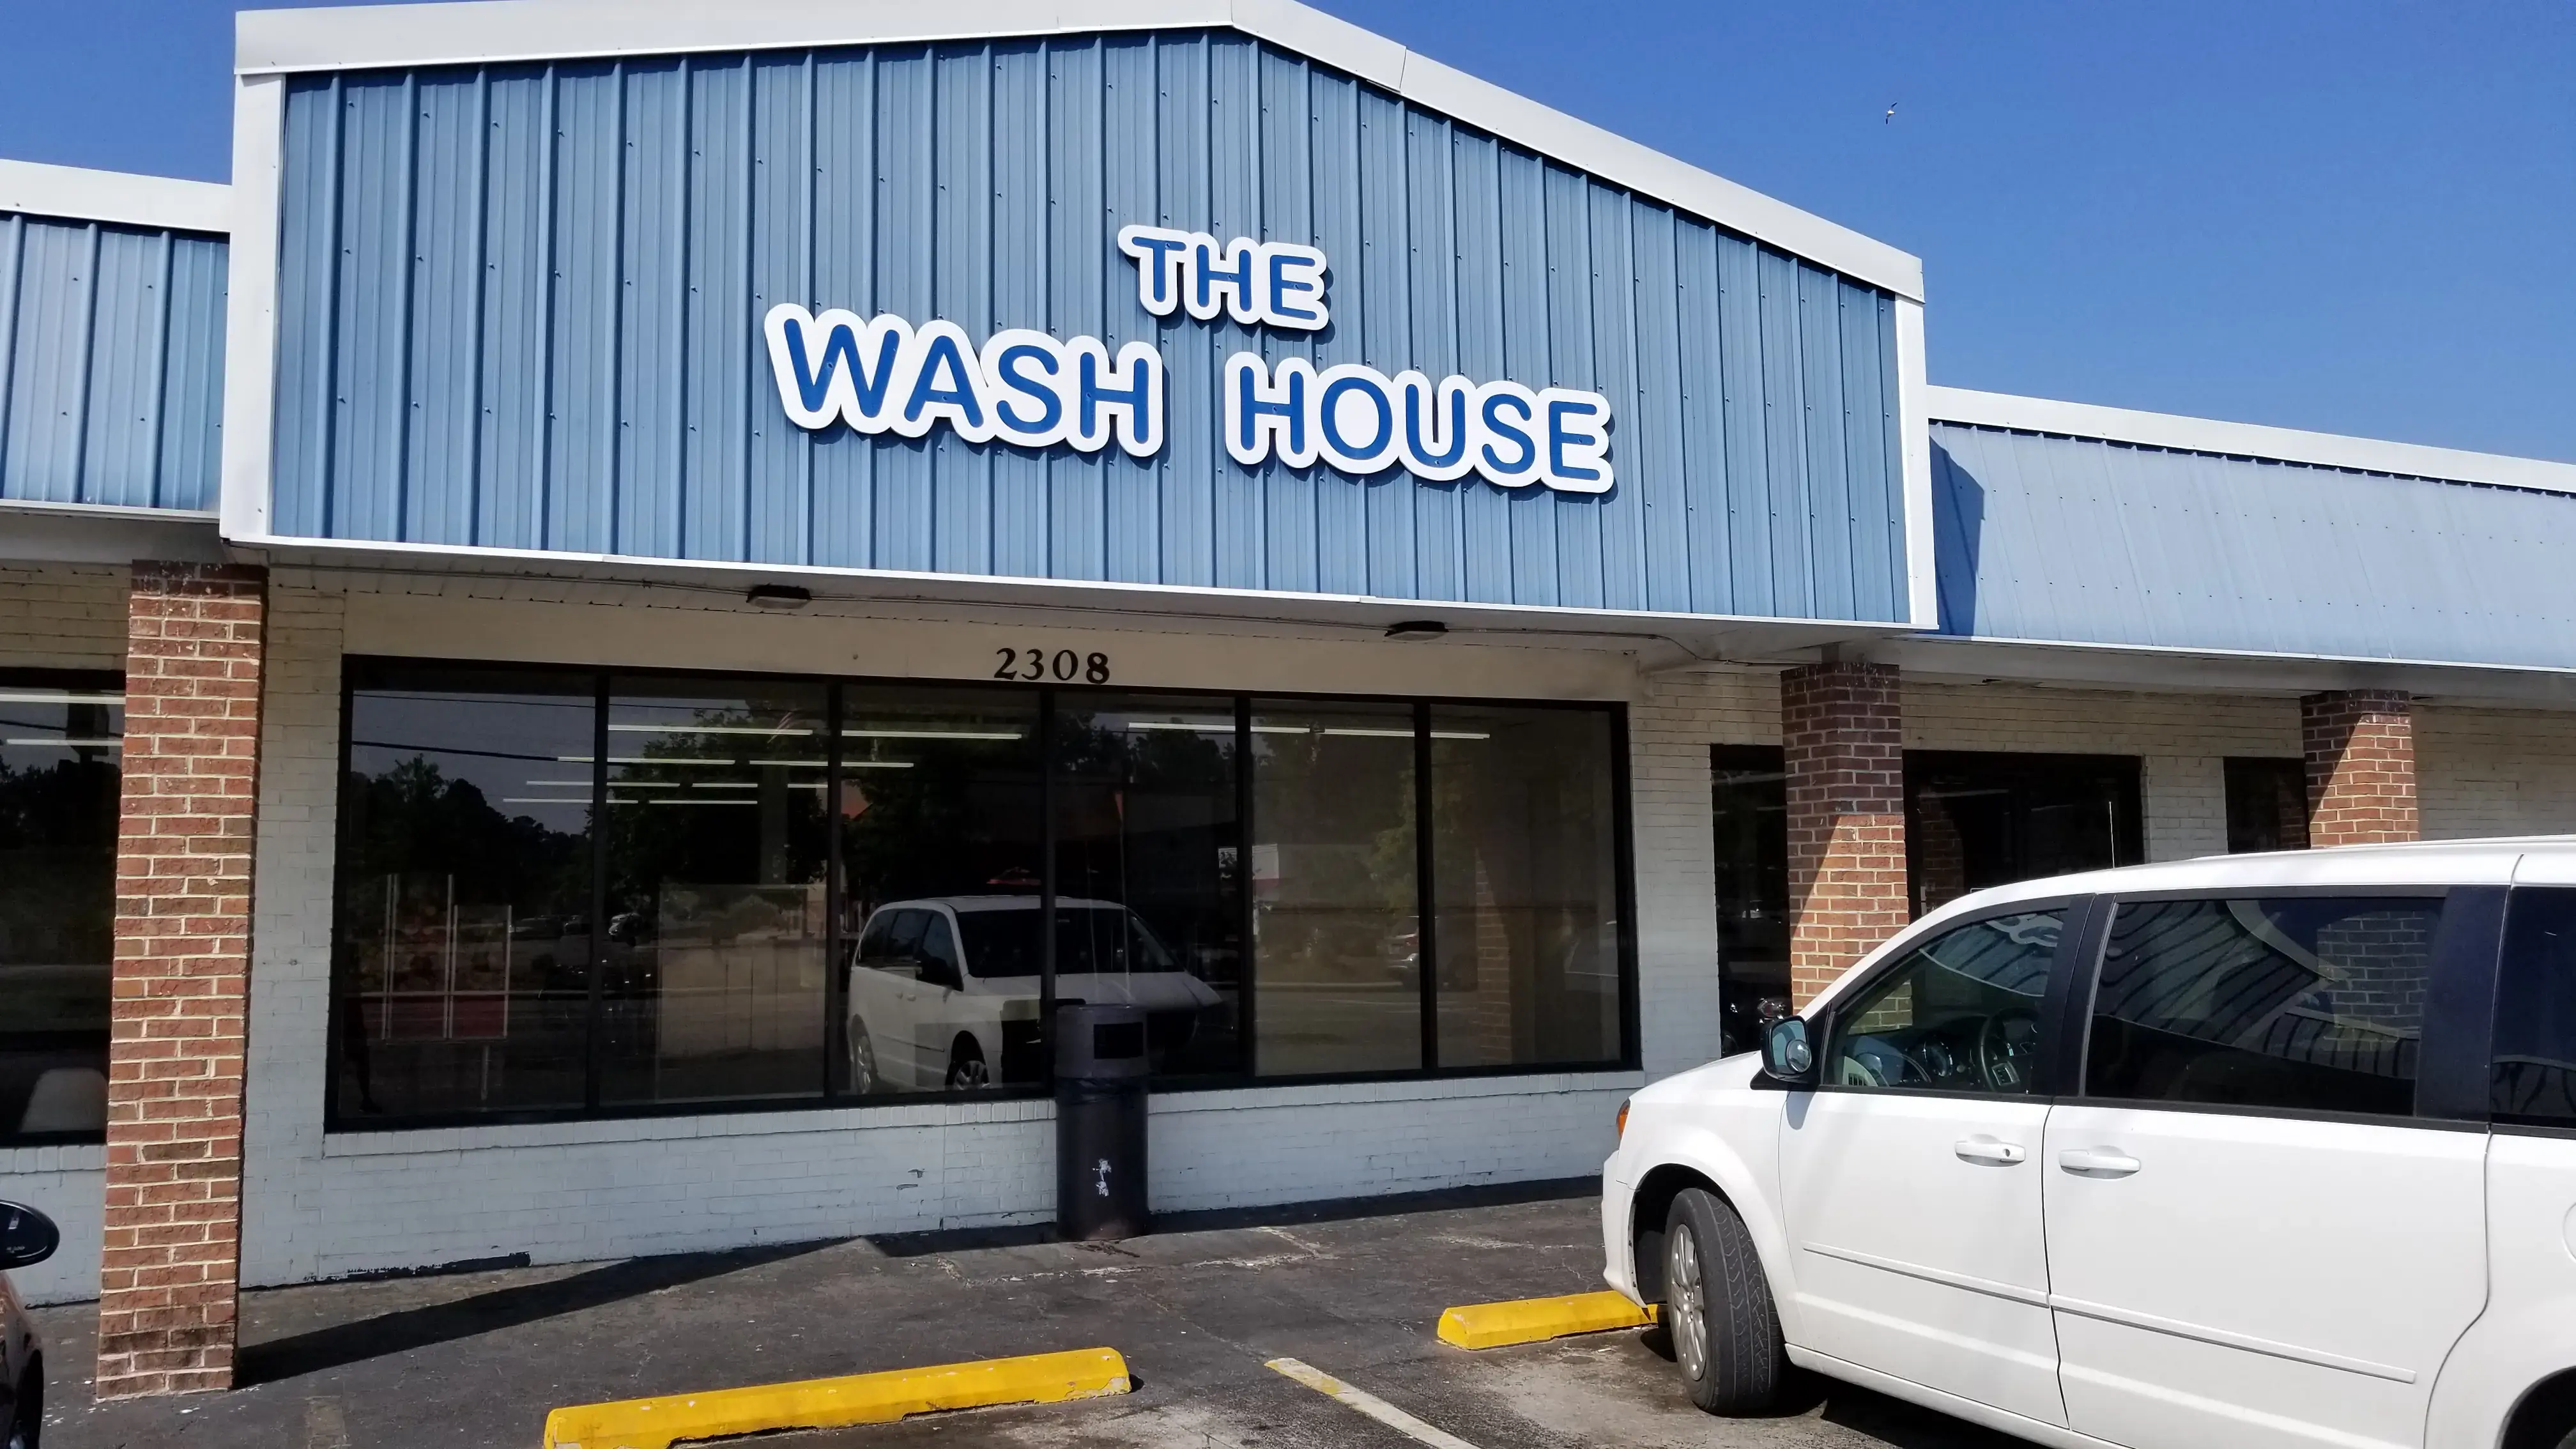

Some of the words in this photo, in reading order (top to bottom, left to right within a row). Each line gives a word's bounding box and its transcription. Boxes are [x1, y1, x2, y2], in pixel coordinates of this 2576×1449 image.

[1130, 234, 1322, 322] THE
[781, 316, 1151, 443] WASH
[1238, 364, 1602, 482] HOUSE
[994, 647, 1109, 684] 2308
